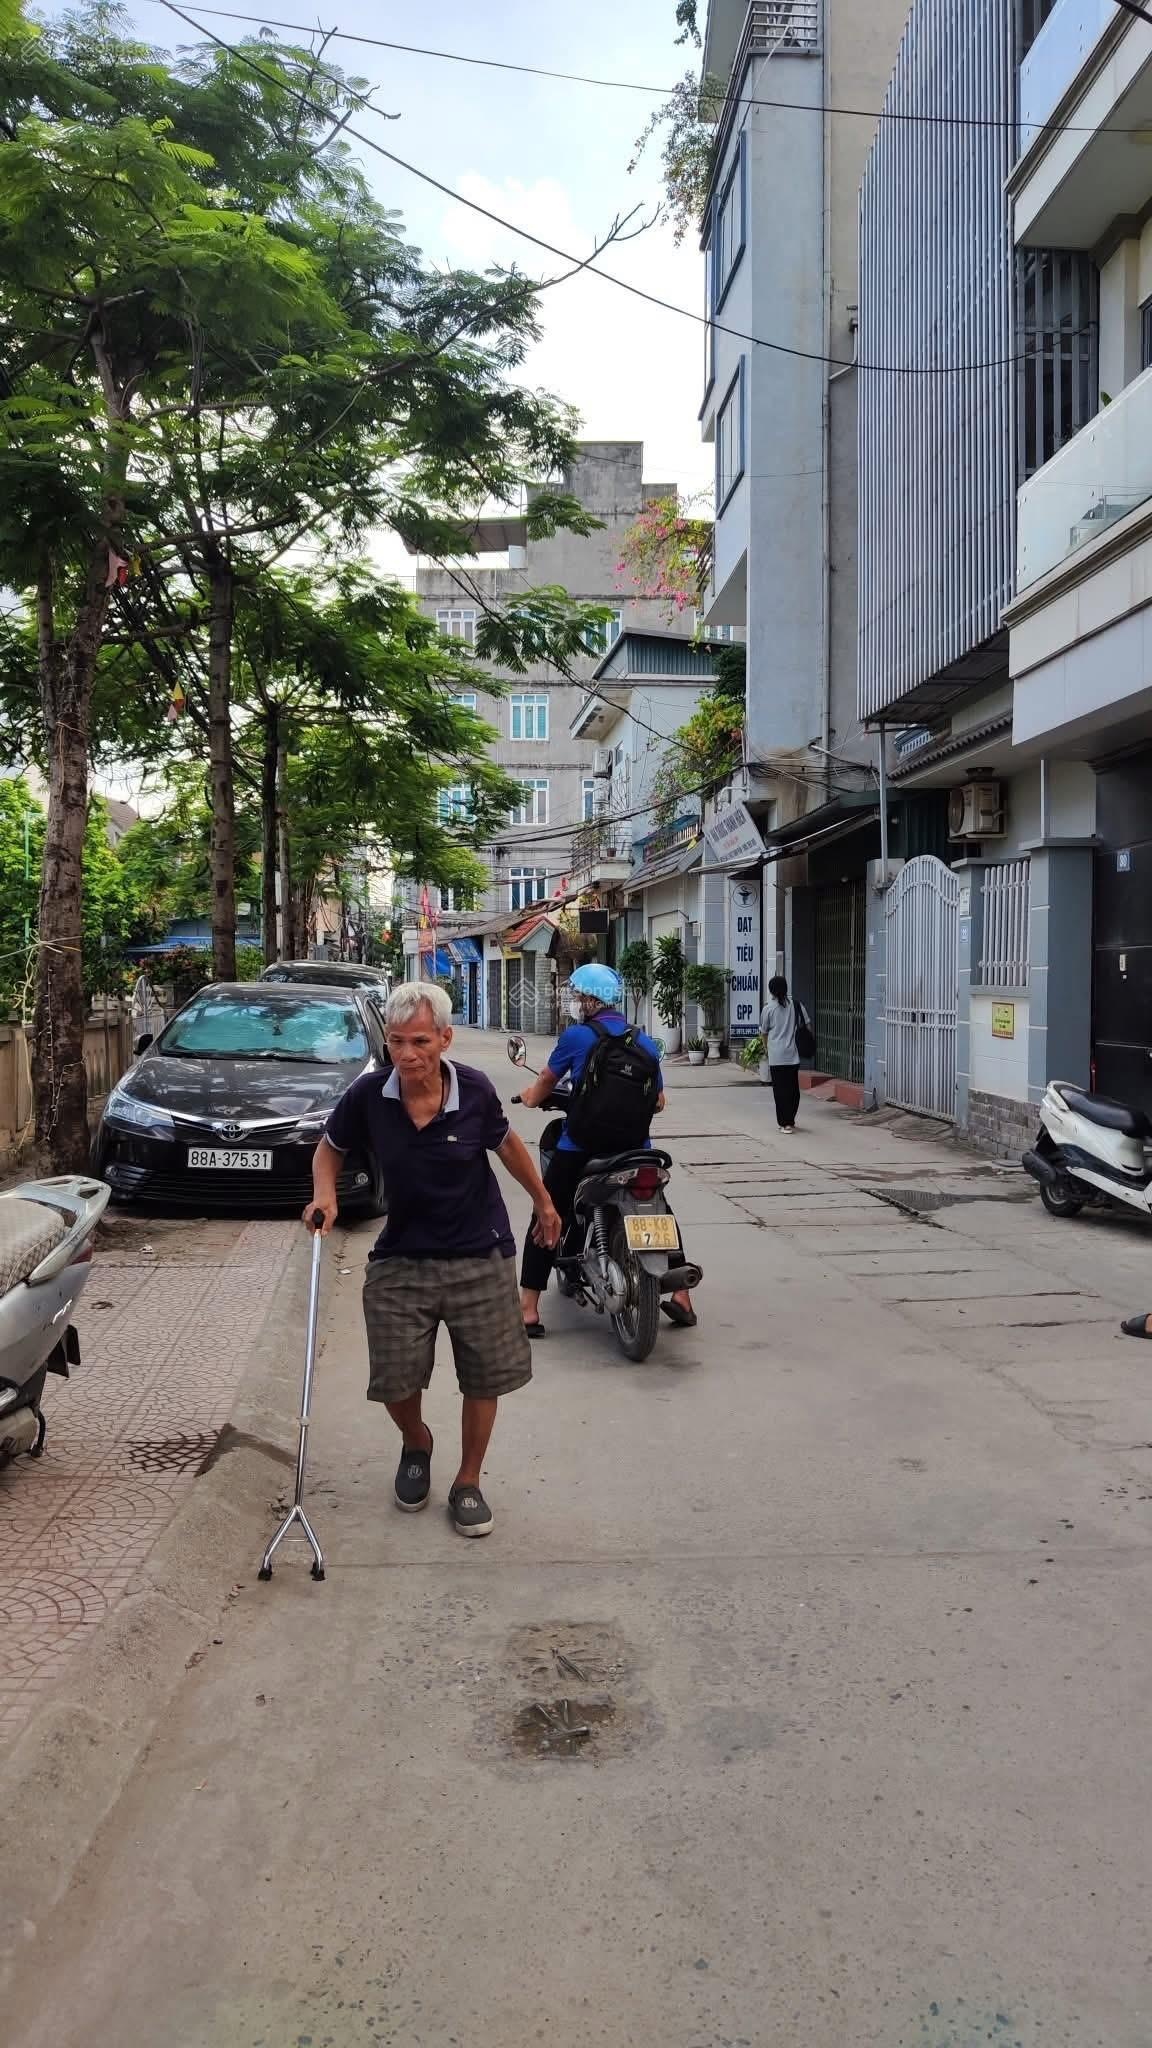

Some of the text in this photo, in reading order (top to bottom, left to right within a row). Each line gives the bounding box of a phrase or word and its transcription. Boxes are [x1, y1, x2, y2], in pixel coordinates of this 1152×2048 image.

[736, 943, 753, 961] TIÊU
[737, 1004, 753, 1021] GPP
[191, 1150, 268, 1168] 88A-375.31
